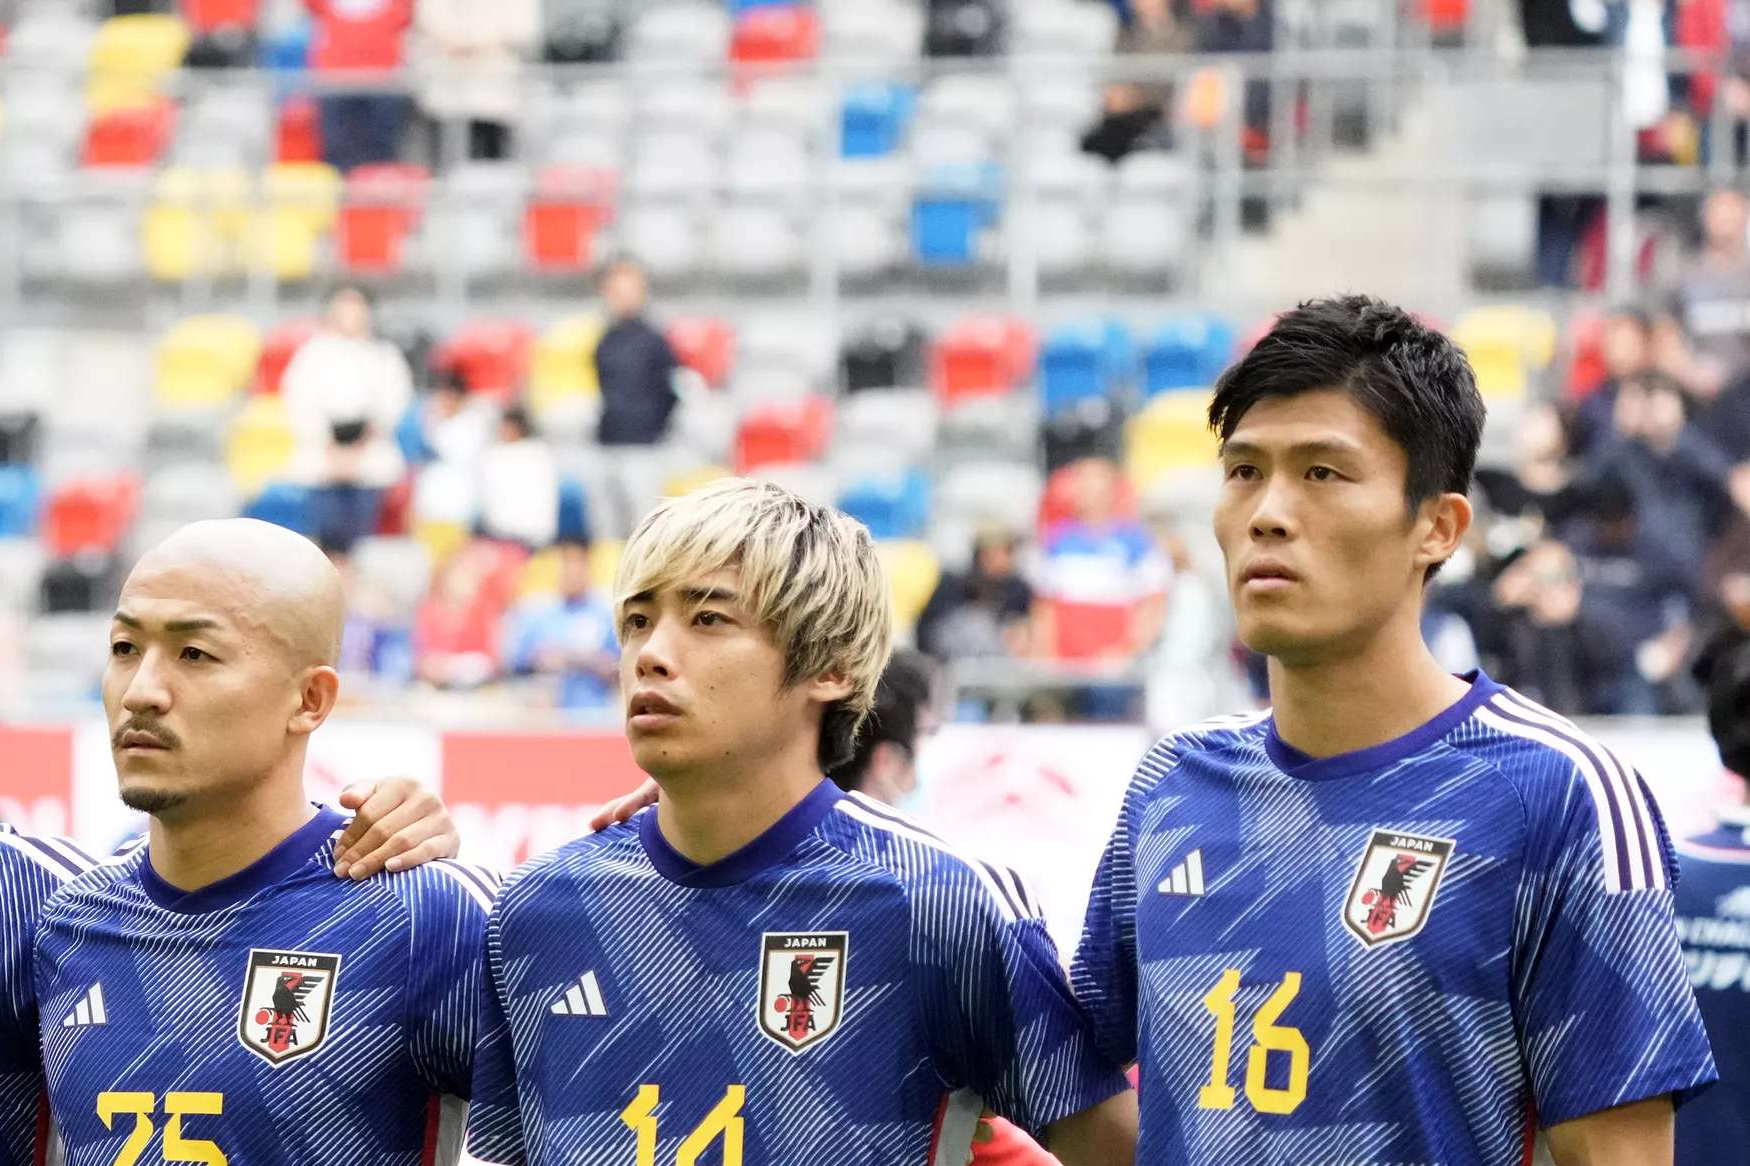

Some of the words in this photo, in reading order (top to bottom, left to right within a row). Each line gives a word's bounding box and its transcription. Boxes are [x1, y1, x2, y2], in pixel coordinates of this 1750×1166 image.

[1389, 836, 1434, 852] JAPAN
[784, 937, 827, 948] JAPAN
[271, 955, 317, 967] JAPAN
[779, 1014, 817, 1032] JFA
[259, 1027, 298, 1046] JFA
[1200, 970, 1310, 1114] 16
